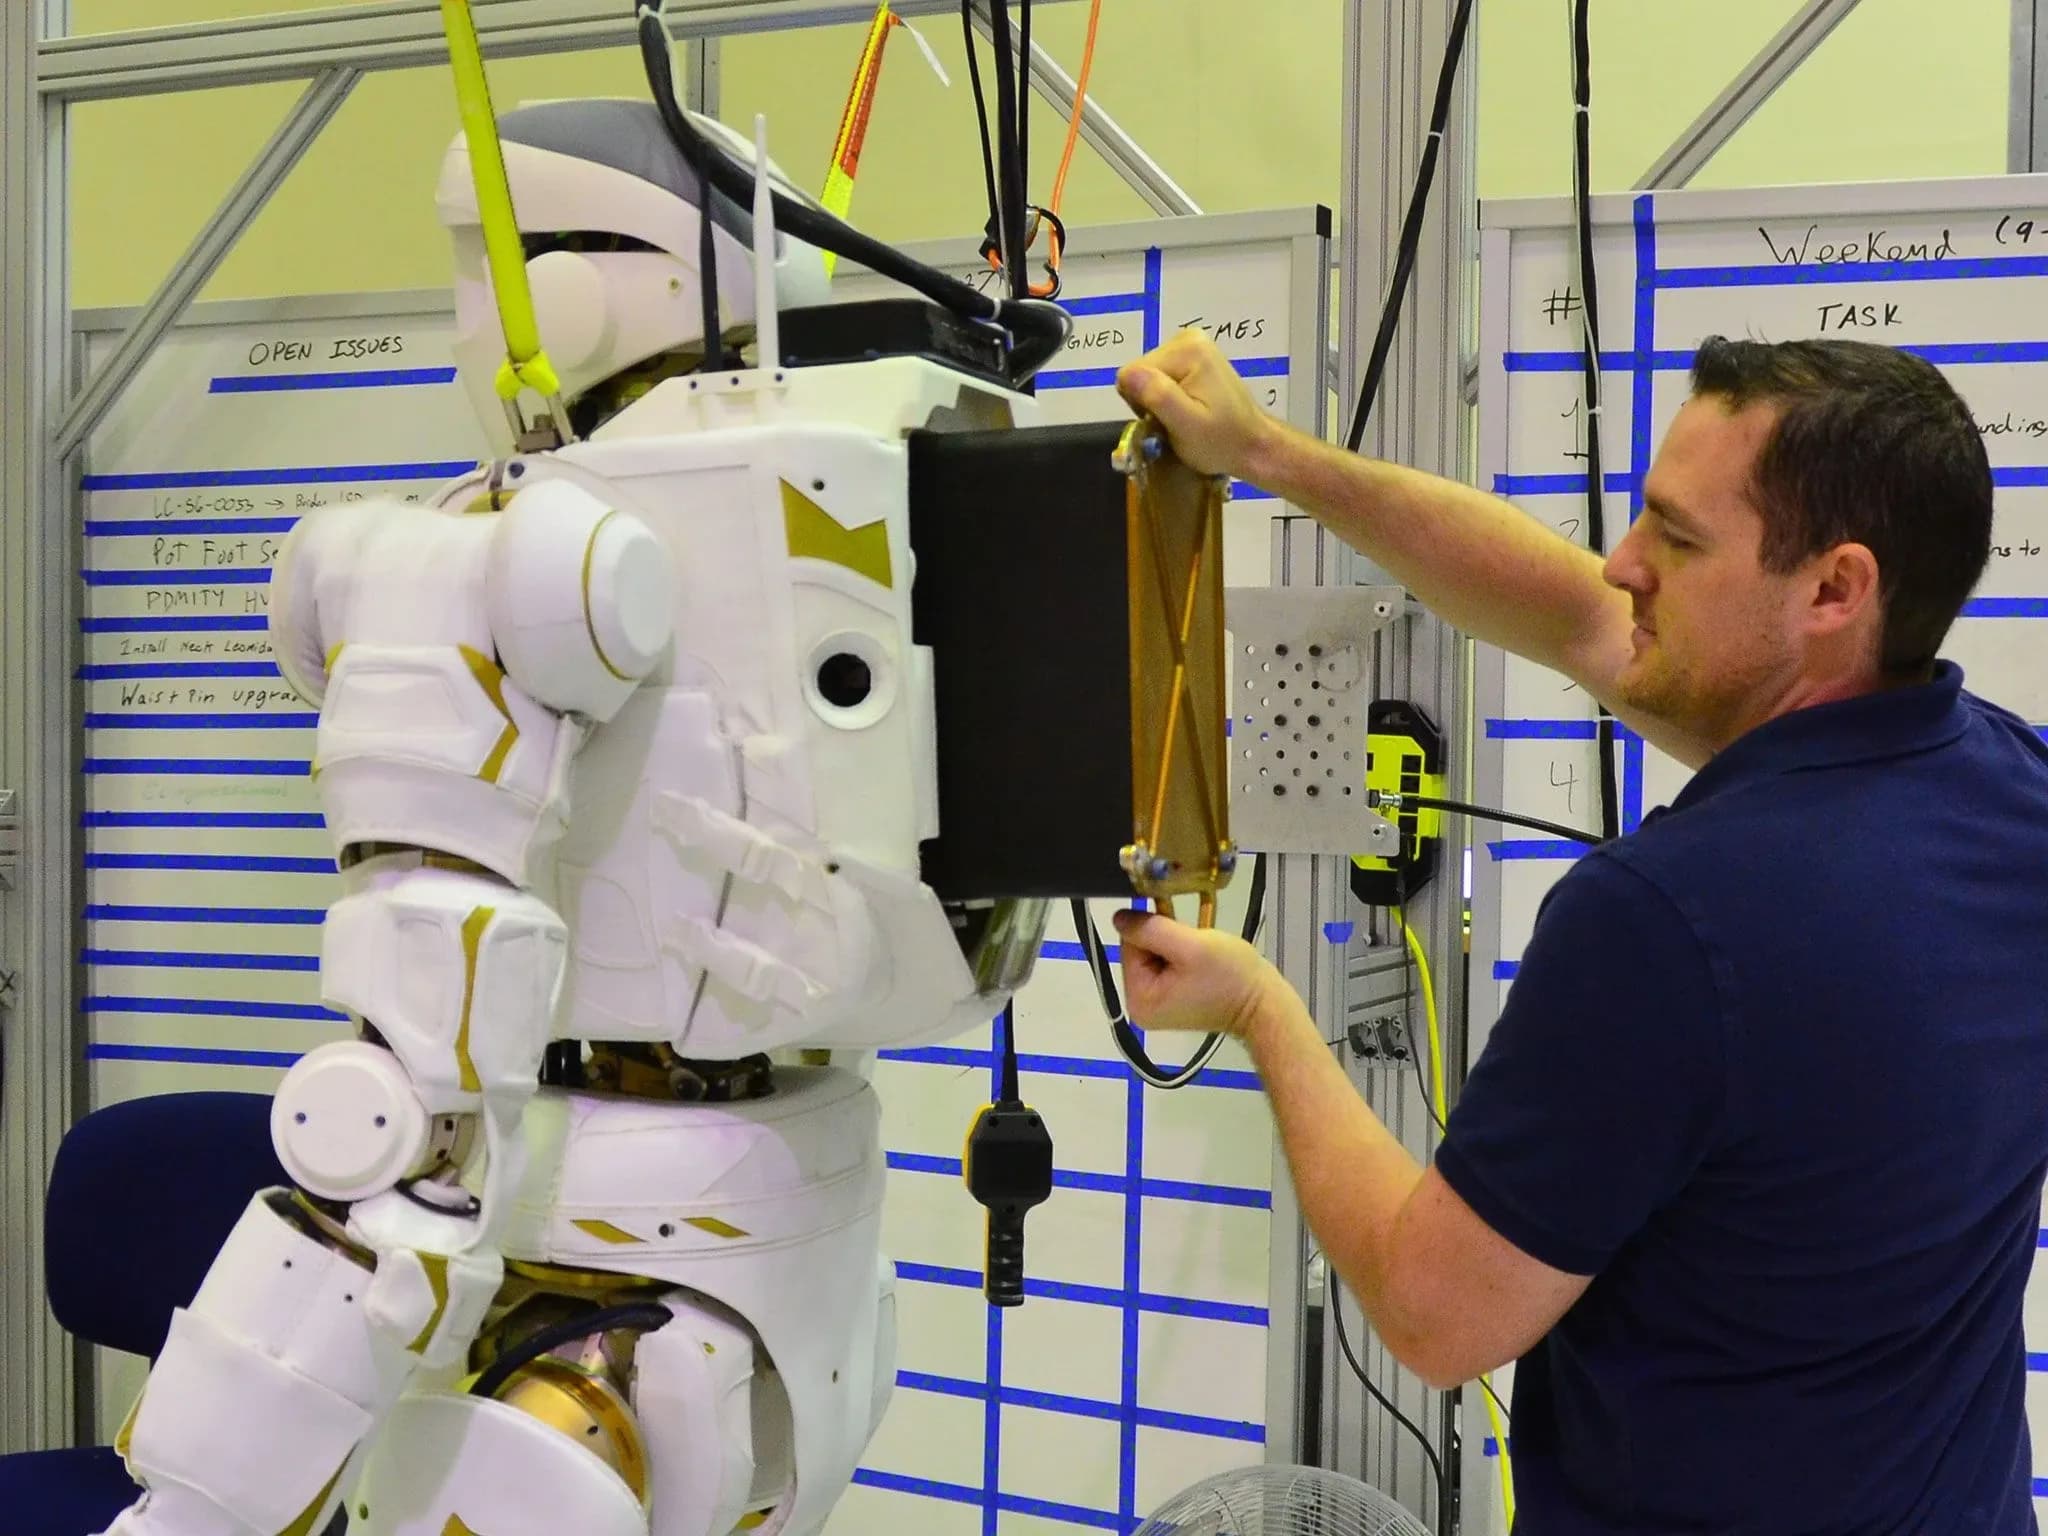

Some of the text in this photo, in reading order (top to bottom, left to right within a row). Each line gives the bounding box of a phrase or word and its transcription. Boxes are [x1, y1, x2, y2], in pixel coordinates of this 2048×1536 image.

[1818, 303, 1902, 331] TASK
[249, 335, 403, 366] OPEN ISSUES
[1058, 331, 1125, 350] GNED
[2019, 539, 2040, 556] to
[1550, 761, 1578, 813] 4
